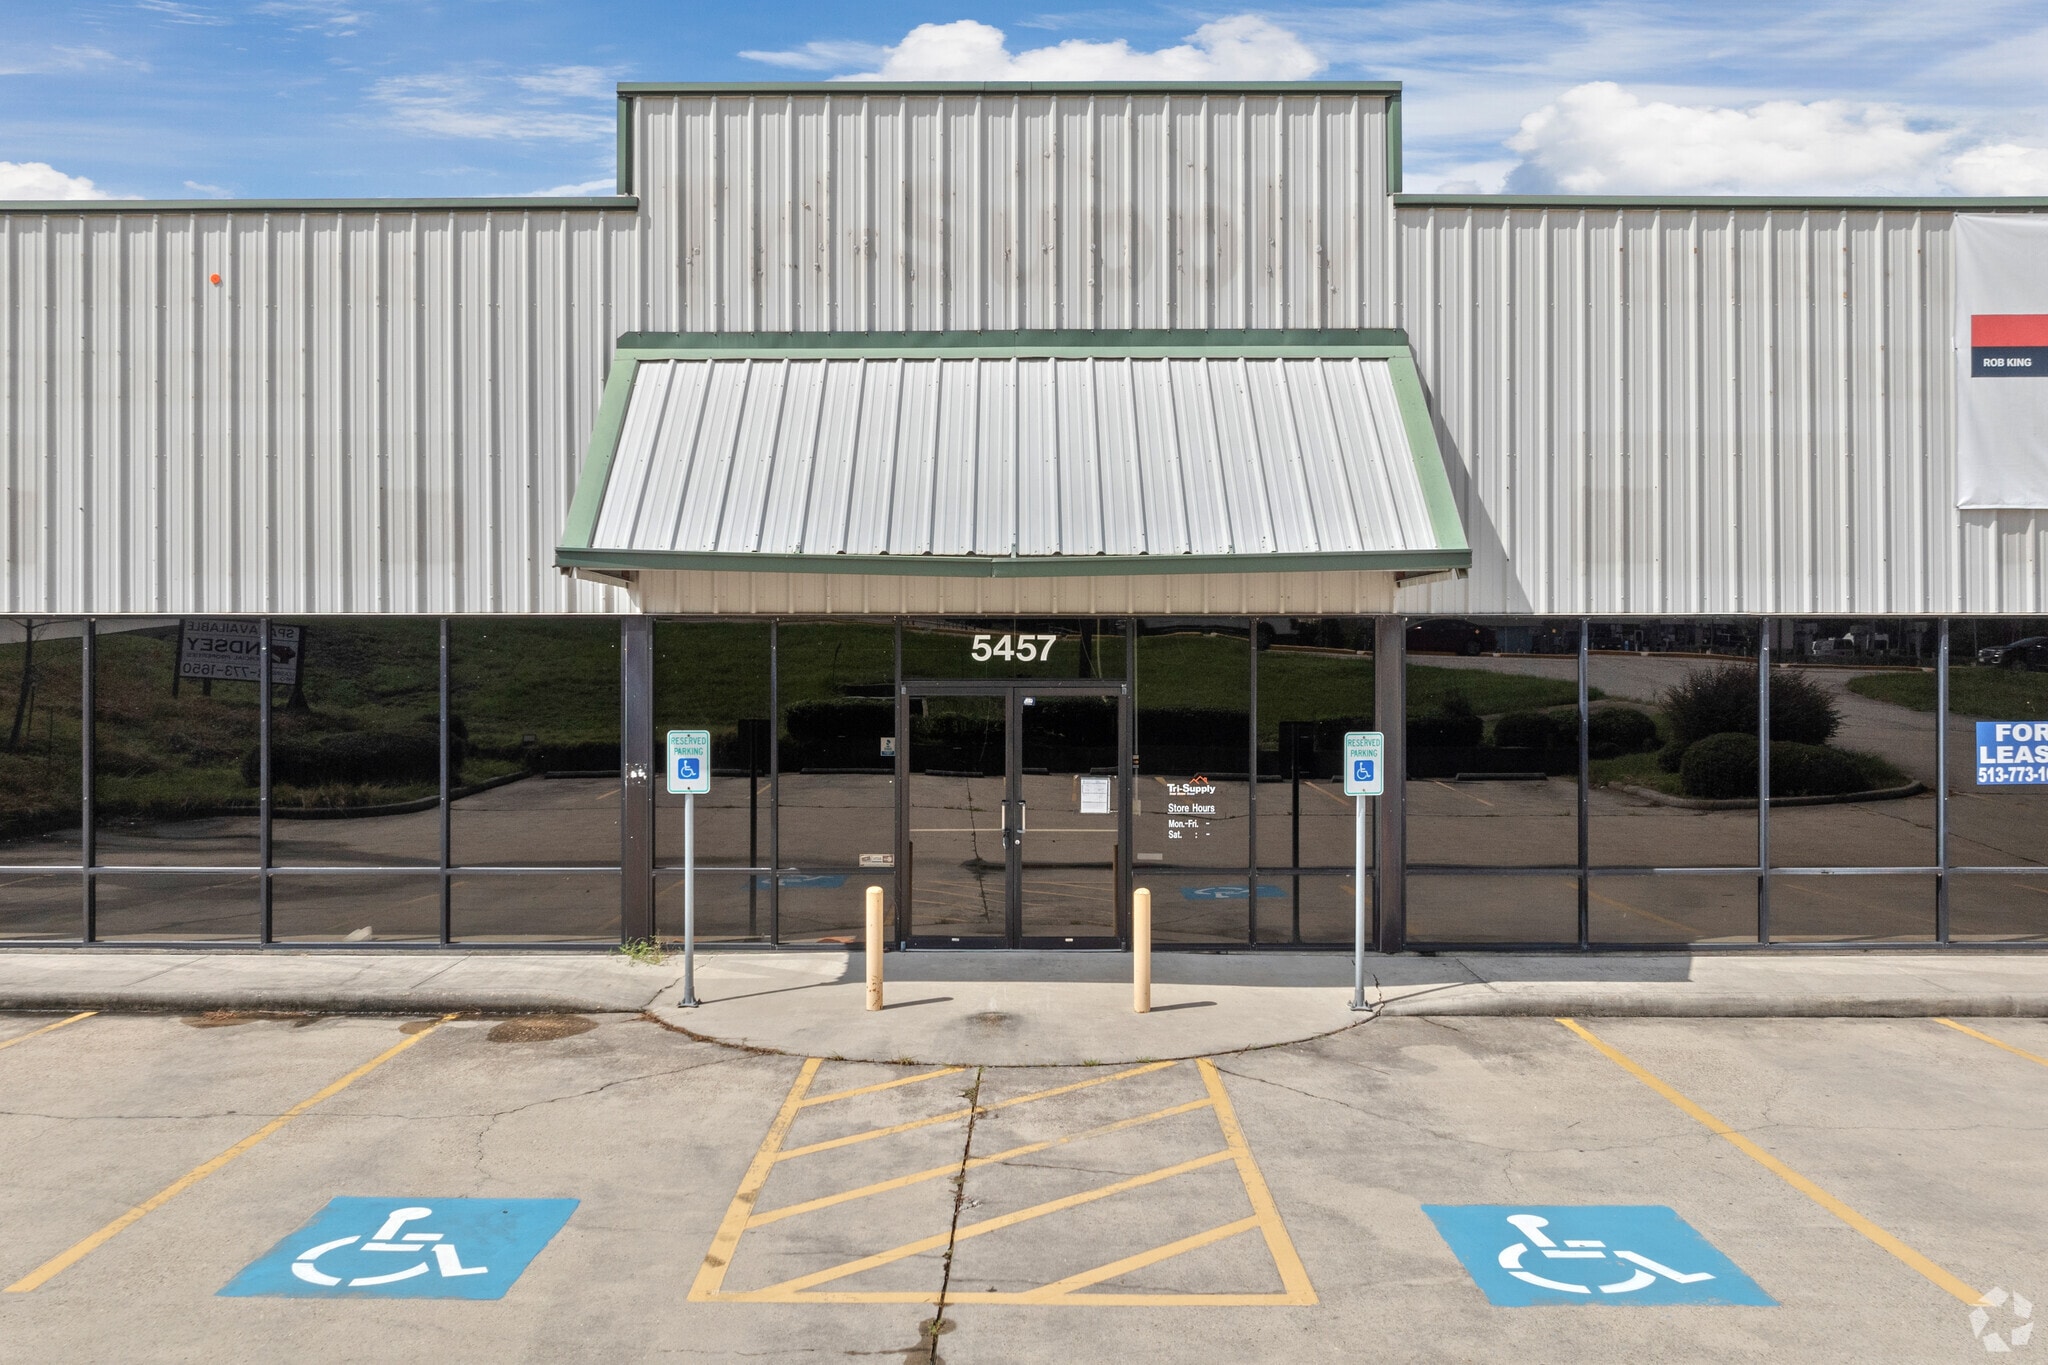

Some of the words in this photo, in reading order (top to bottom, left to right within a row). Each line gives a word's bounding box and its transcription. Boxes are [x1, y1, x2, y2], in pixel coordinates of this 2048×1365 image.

[1983, 358, 2005, 367] ROB
[2006, 358, 2032, 367] KING
[971, 634, 1057, 662] 5457
[1995, 723, 2048, 742] FOR
[671, 736, 707, 745] RESERVED
[1347, 738, 1381, 747] RESERVED
[673, 747, 704, 756] PARKING
[1350, 749, 1378, 758] PARKING
[1980, 745, 2048, 764] LEAS
[1978, 766, 2048, 782] 513-773-1
[1166, 783, 1216, 795] Tri-Supply
[1167, 803, 1190, 812] Store
[1192, 803, 1215, 812] Hours
[1168, 830, 1183, 839] Sat.
